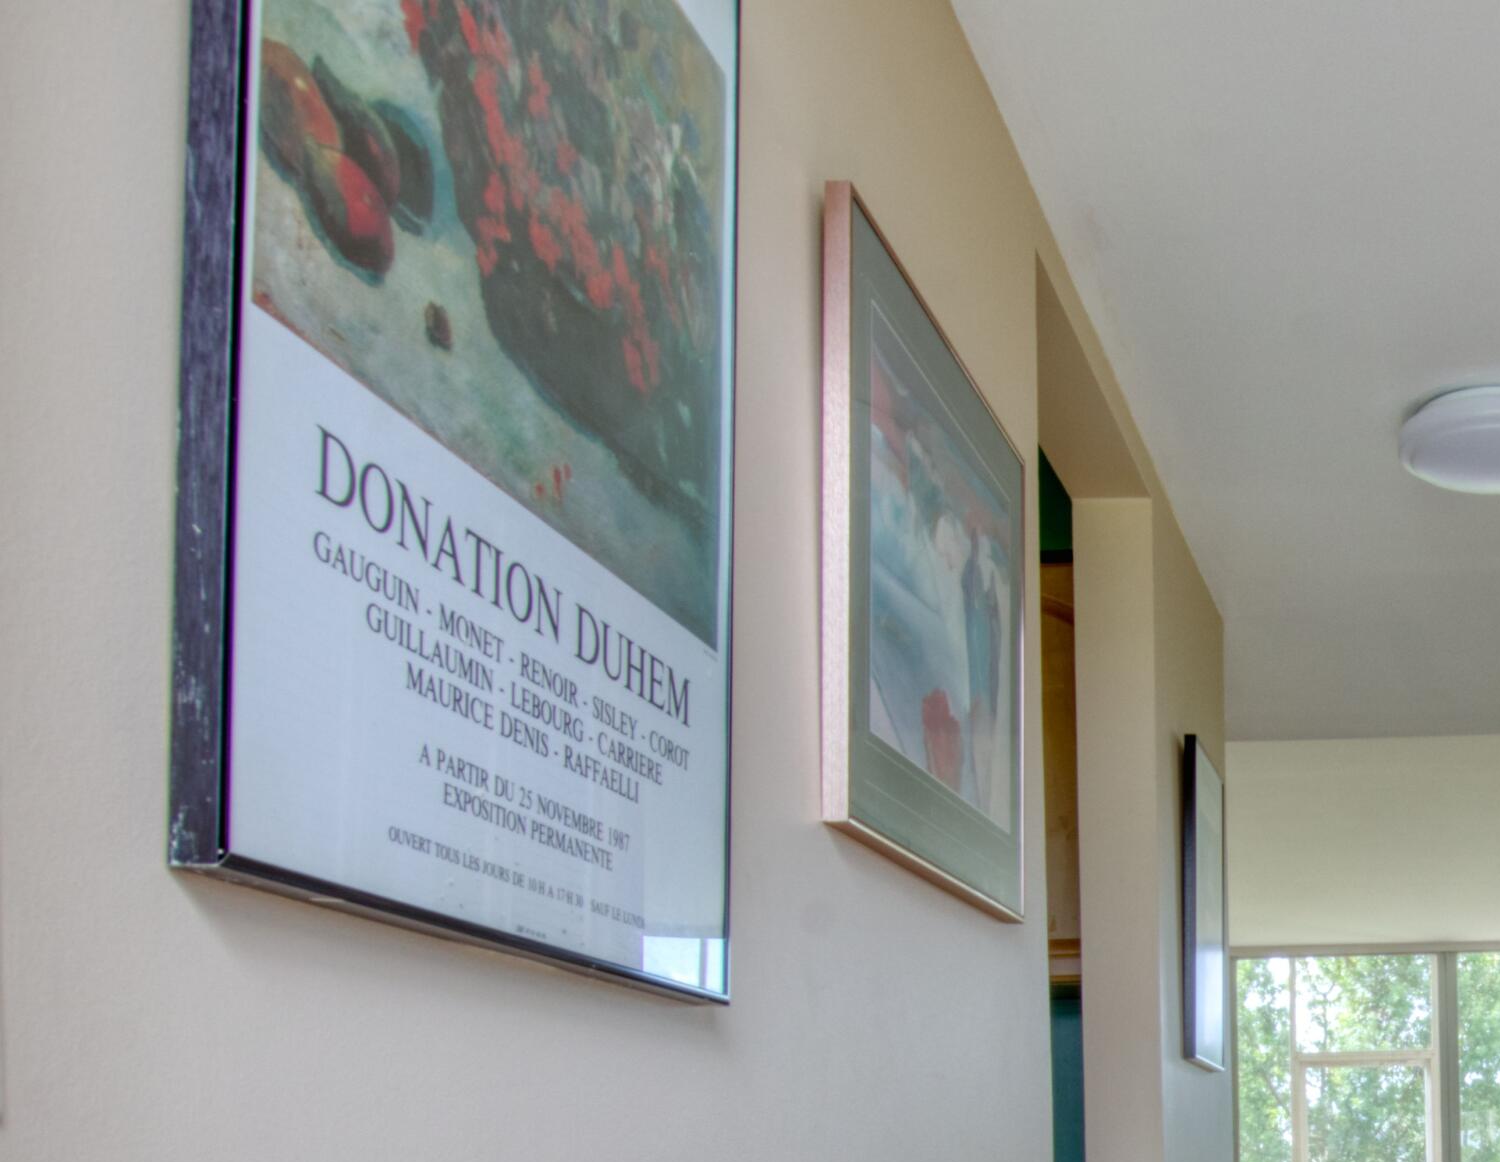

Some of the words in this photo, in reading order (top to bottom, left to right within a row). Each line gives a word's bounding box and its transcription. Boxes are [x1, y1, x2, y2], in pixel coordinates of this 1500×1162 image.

[315, 424, 563, 643] DONATION
[575, 602, 691, 728] DUHEM
[313, 531, 420, 615] GAUGUIN
[439, 602, 505, 664] MONET
[520, 651, 579, 708] RENOIR
[592, 696, 638, 741] SISLEY
[649, 730, 690, 771] COROT
[366, 602, 494, 693] GUILLAUMIN
[511, 681, 584, 743] LEBOURG
[597, 731, 663, 786] CARRIERE
[405, 660, 494, 731] MAURICE
[500, 710, 549, 759] DENIS
[563, 744, 640, 804] RAFFAELLI
[418, 743, 431, 767] A
[436, 748, 489, 792] PARTIR
[494, 774, 515, 802] DU
[519, 786, 533, 810] 25
[536, 793, 604, 842] NOVEMBRE
[608, 826, 631, 854] 1987
[388, 825, 432, 855] OUVERT
[434, 841, 460, 865] TOUS
[462, 852, 481, 872] LES
[481, 860, 511, 883] JOURS
[512, 870, 526, 888] DE
[443, 782, 527, 835] EXPOSITION
[530, 820, 614, 872] PERMANENTE
